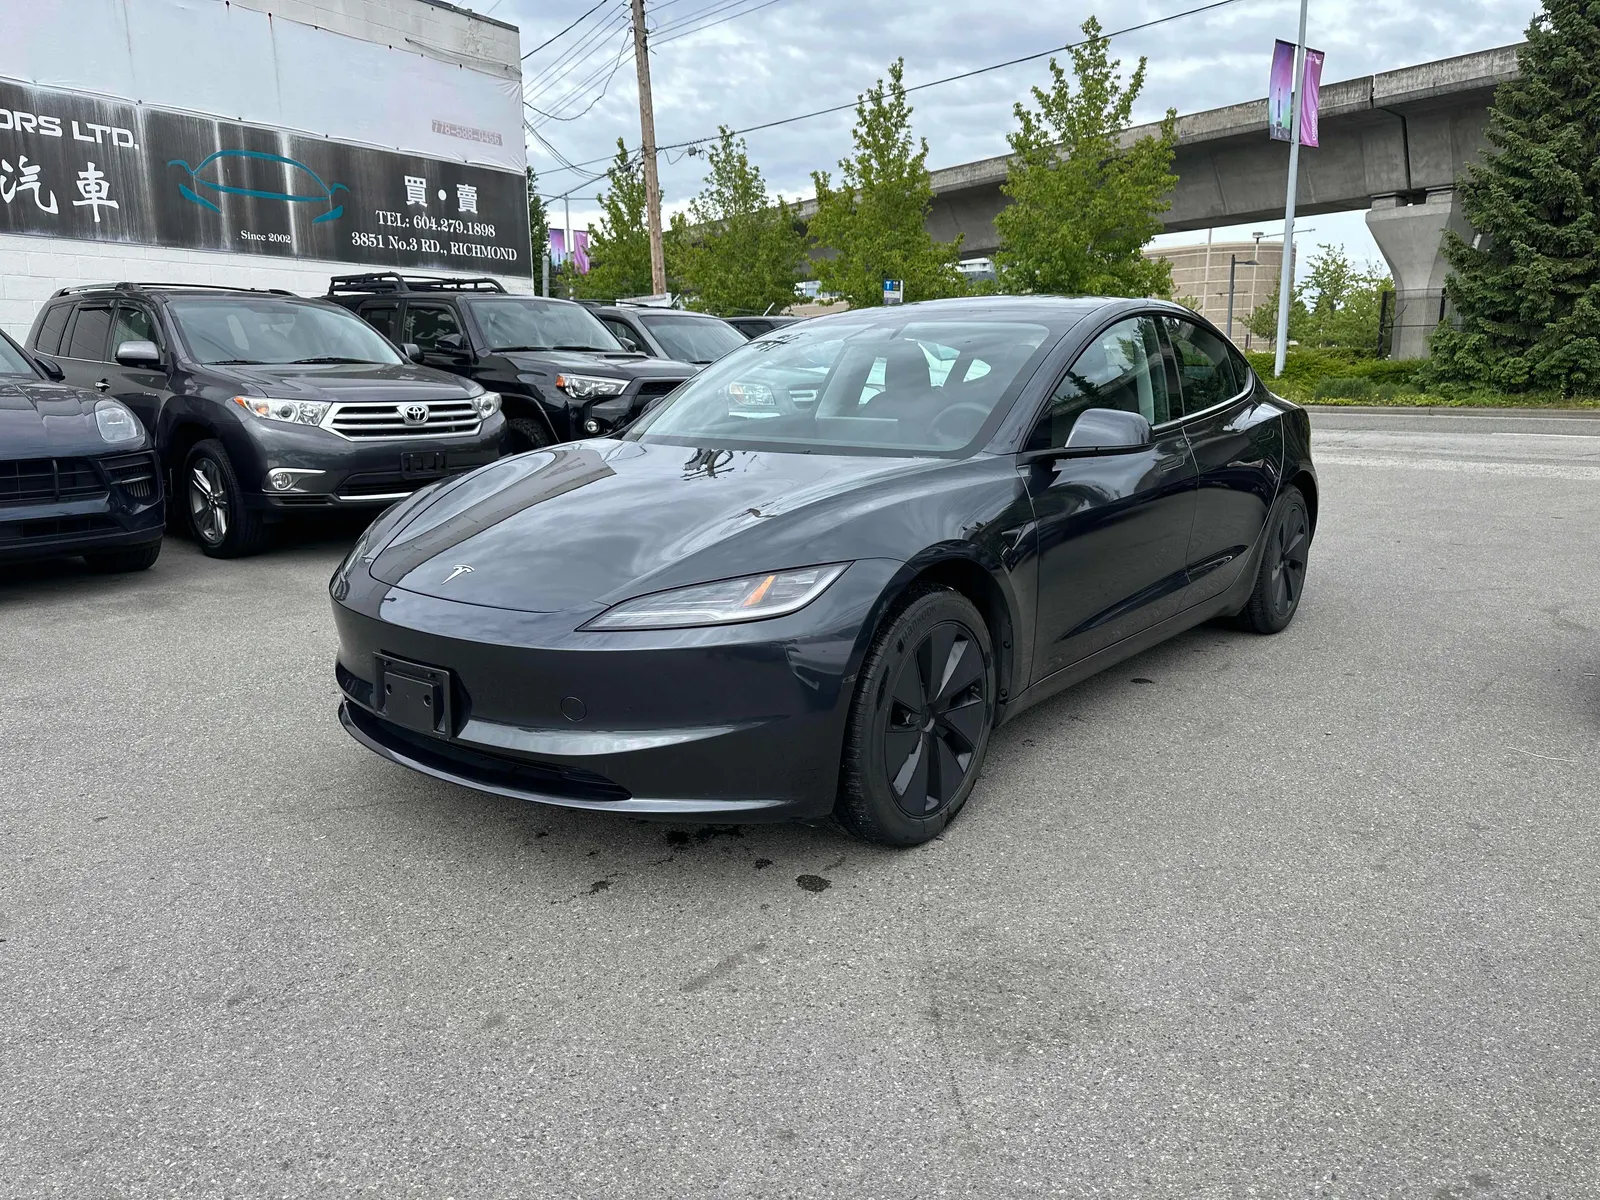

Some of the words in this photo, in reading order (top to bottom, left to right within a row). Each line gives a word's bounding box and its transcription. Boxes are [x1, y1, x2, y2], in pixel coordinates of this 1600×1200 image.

[71, 120, 140, 149] LTD.
[432, 120, 500, 145] 778-588-0456
[240, 230, 266, 241] Since
[268, 232, 291, 243] 2002
[375, 210, 410, 227] TEL:
[413, 215, 496, 237] 604.279.1898
[351, 231, 385, 248] 3851
[388, 235, 418, 251] No.3
[420, 239, 448, 256] RD.,
[449, 242, 518, 261] RICHMOND
